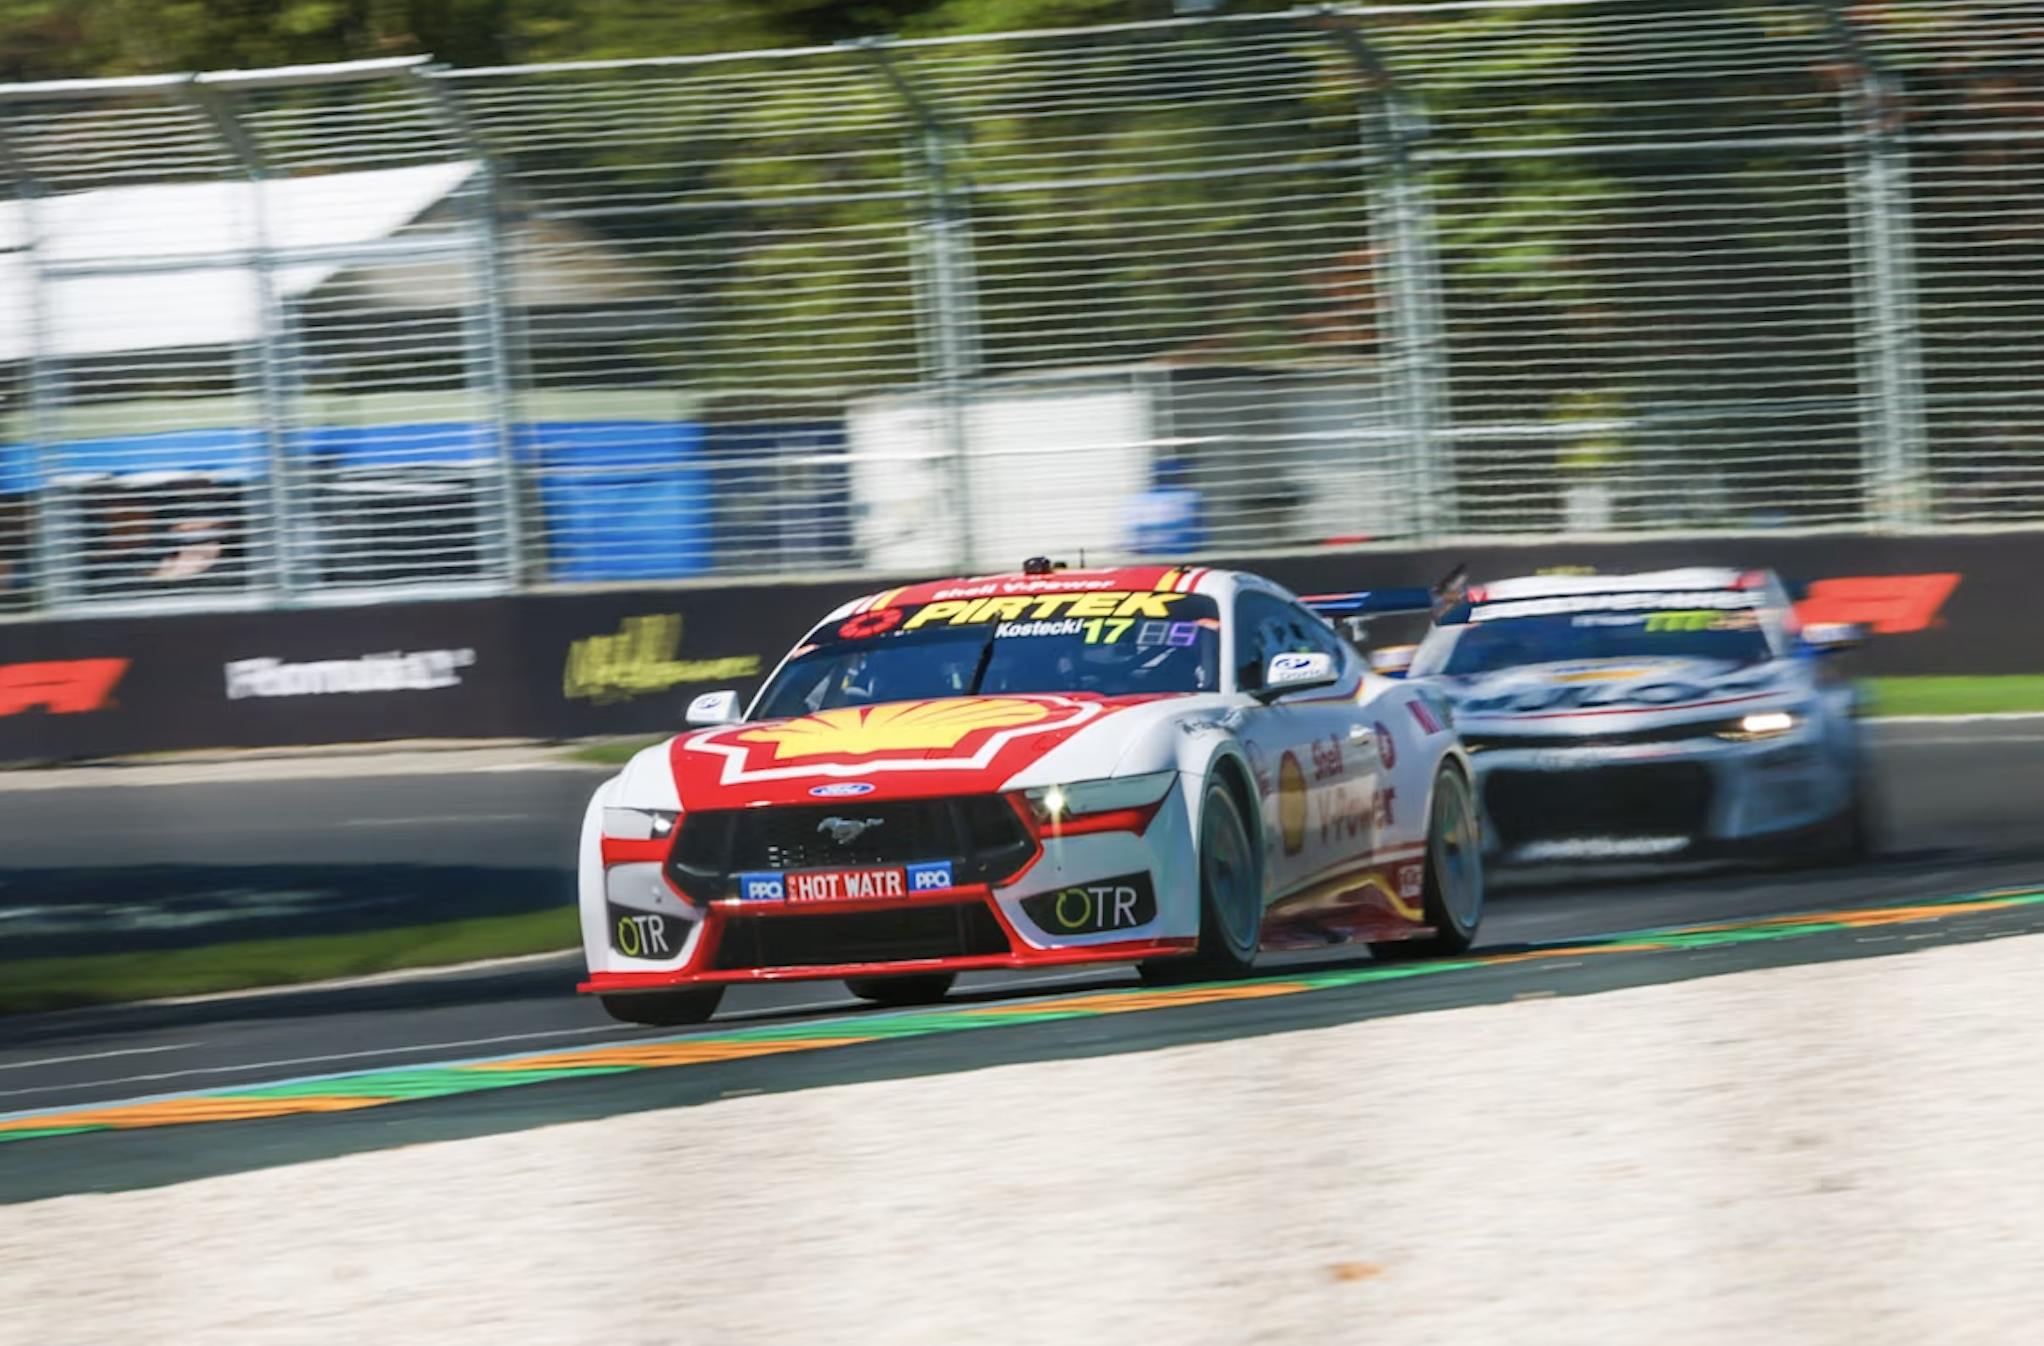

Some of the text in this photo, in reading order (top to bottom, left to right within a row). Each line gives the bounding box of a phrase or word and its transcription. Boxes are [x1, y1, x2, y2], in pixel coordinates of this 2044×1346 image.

[932, 583, 998, 600] Shell
[903, 592, 1187, 630] PIRTEK
[994, 617, 1136, 644] Kostecki 17
[748, 881, 783, 899] PPQ
[798, 874, 840, 900] HOT
[843, 871, 903, 899] WATR
[915, 870, 950, 889] PPQ
[1055, 886, 1137, 929] OTR
[618, 914, 670, 956] OTR
